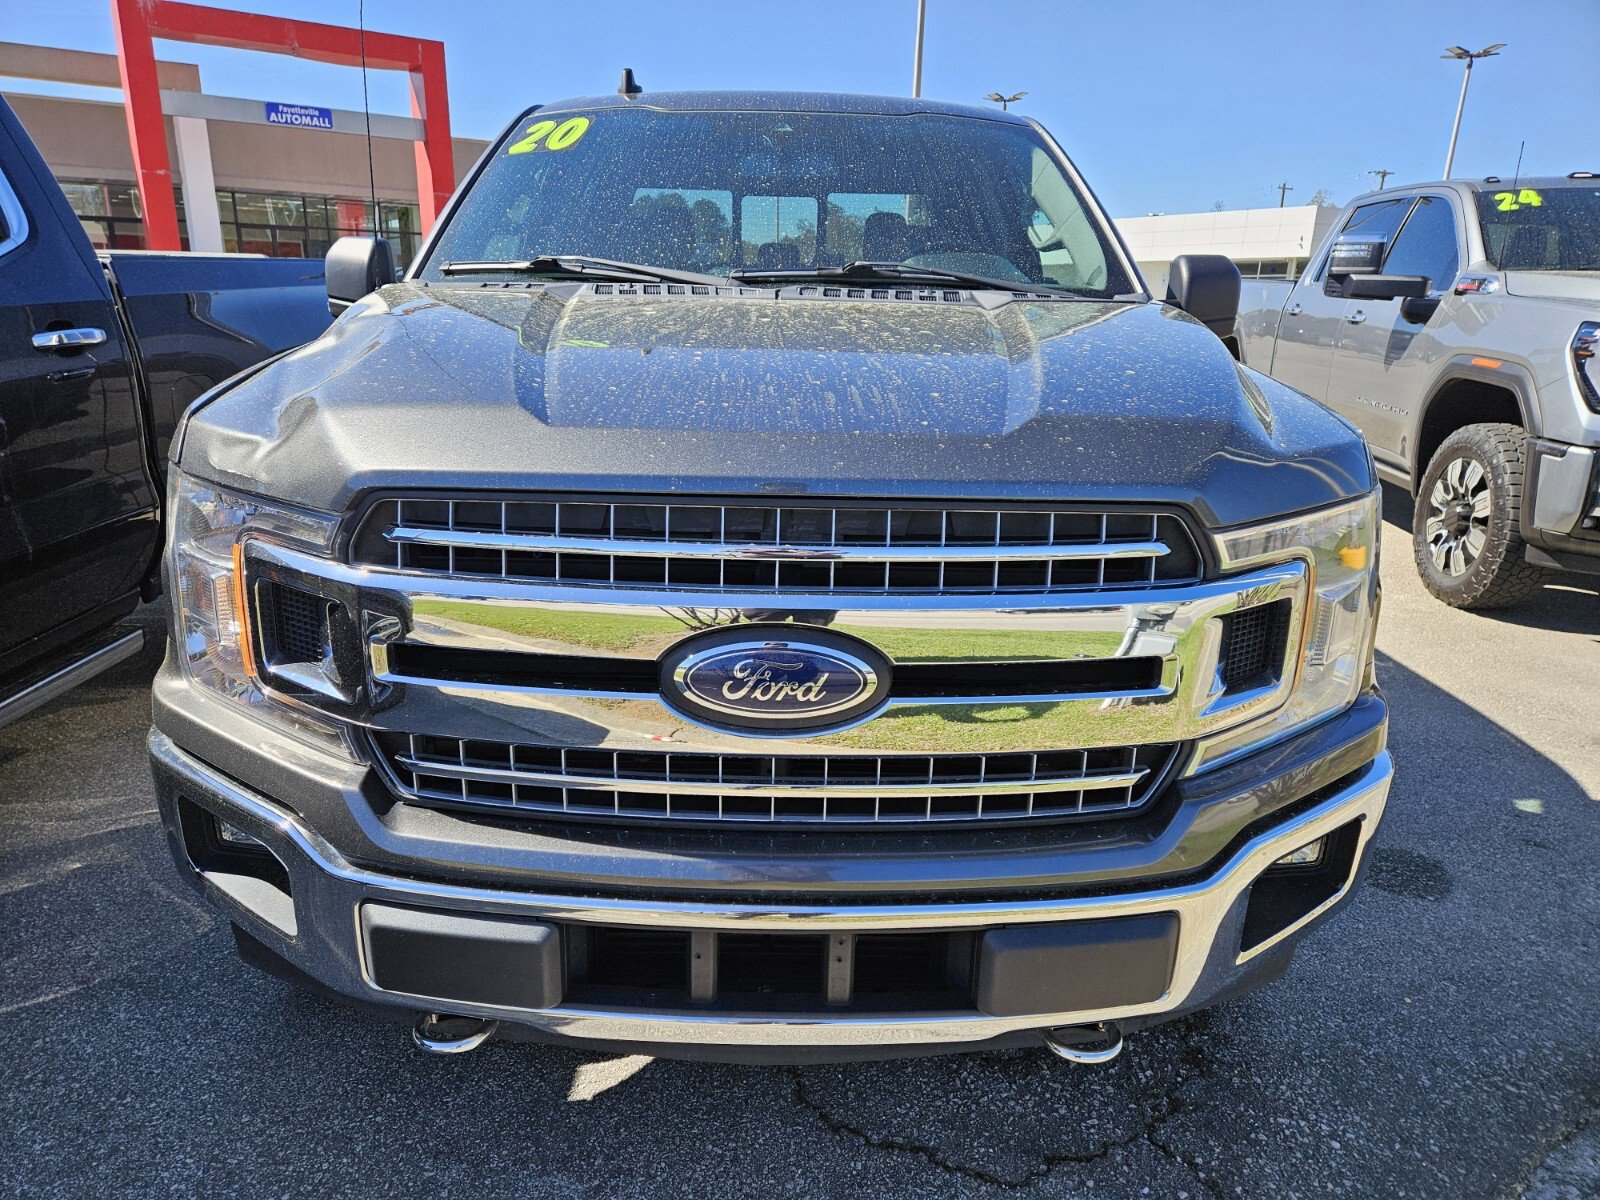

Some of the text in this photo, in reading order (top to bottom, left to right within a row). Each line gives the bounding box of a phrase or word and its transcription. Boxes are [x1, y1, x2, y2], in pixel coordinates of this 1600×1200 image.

[269, 112, 331, 128] AUTOMALL
[279, 104, 319, 116] Fayetteville
[508, 117, 590, 155] 20
[1494, 189, 1542, 211] 24
[722, 659, 829, 702] Ford
